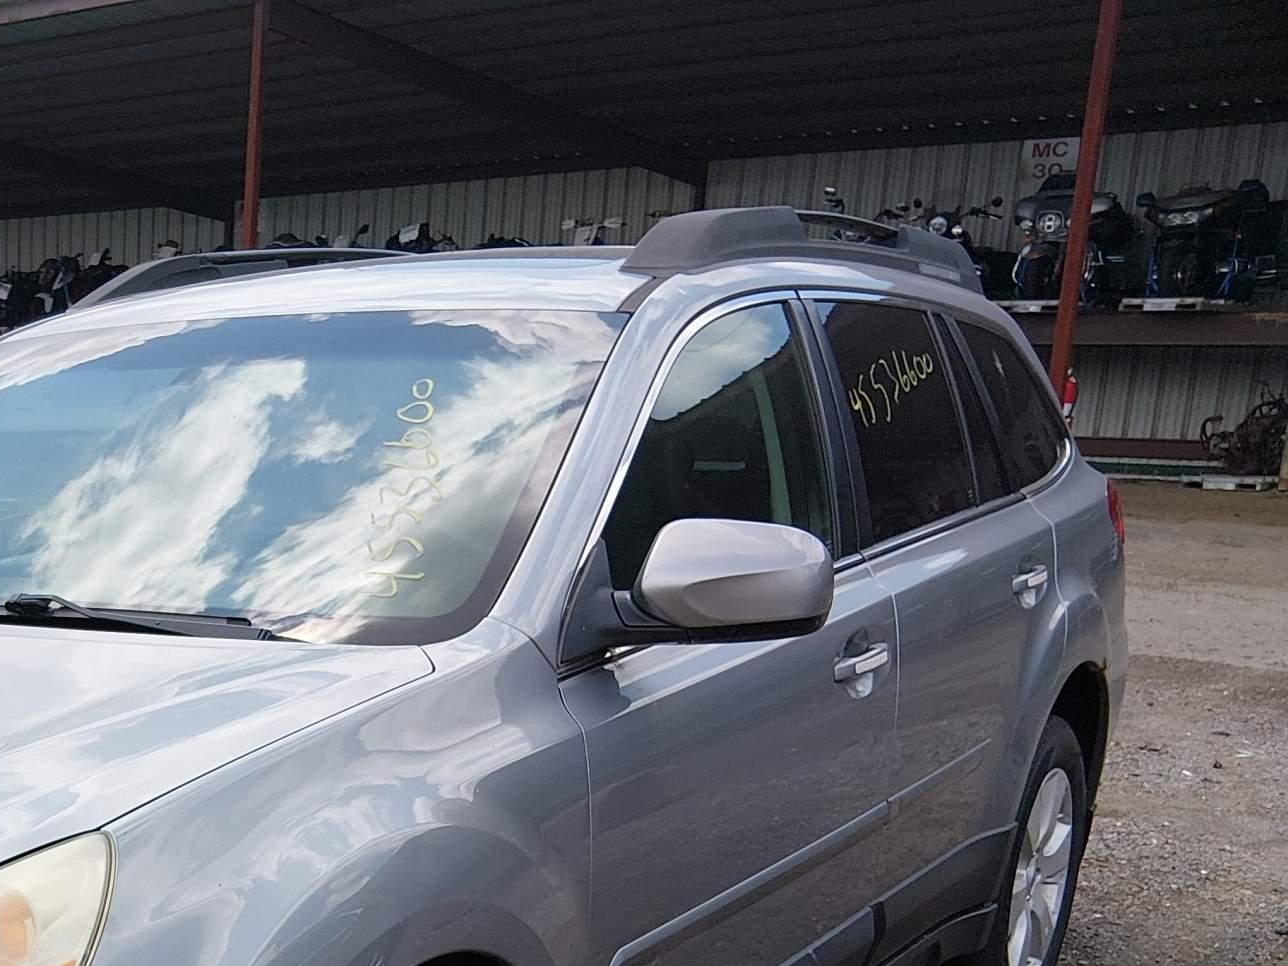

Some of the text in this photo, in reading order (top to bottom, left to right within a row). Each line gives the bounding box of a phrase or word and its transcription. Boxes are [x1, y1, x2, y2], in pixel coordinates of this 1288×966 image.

[1031, 141, 1069, 158] MC
[848, 350, 934, 428] 45536600
[360, 377, 443, 599] 45536600
